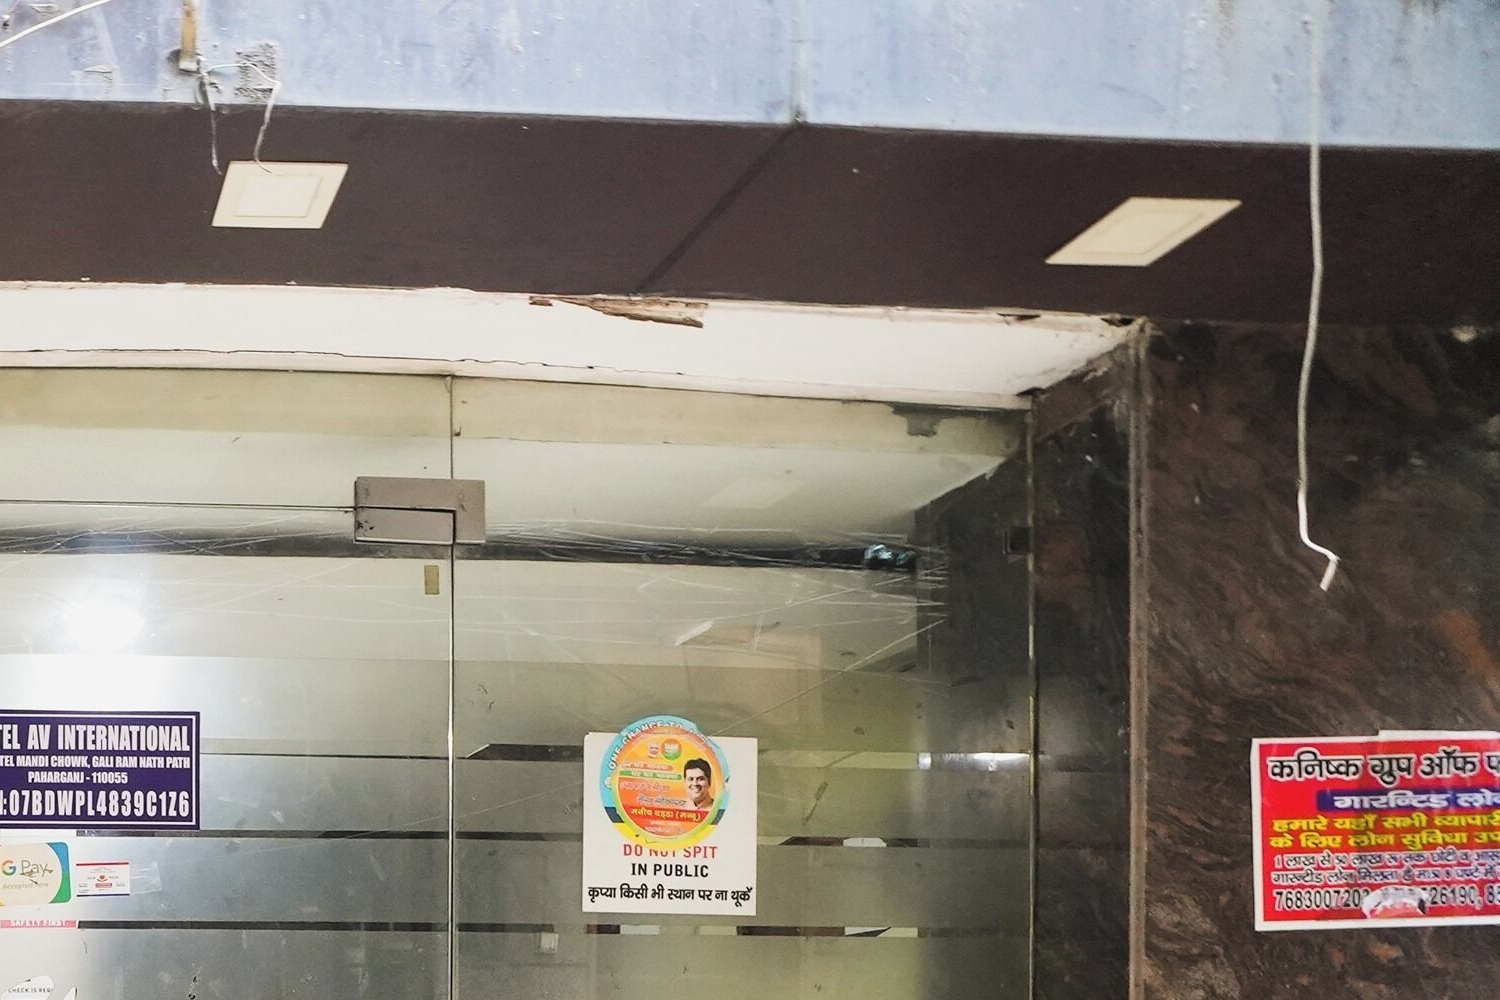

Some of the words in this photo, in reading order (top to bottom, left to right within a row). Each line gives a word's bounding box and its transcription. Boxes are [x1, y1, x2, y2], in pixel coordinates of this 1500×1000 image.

[27, 724, 51, 750] AV
[57, 724, 191, 751] INTERNATIONAL
[16, 755, 49, 768] MANDI
[50, 755, 91, 769] CHOWK,
[92, 756, 114, 768] GALI
[115, 756, 138, 768] RAM
[139, 757, 164, 769] NATH
[166, 757, 191, 769] PATH
[1268, 749, 1363, 778] कनिष्क
[1420, 748, 1479, 776] ऑफ
[27, 771, 84, 783] PAHARGANJ
[92, 772, 129, 784] 110055
[1269, 833, 1294, 847] के
[623, 844, 643, 857] DO
[683, 846, 718, 858] SPIT
[21, 860, 48, 877] Pay
[631, 863, 647, 876] IN
[653, 864, 709, 877] PUBLIC
[587, 886, 616, 902] कृप्या
[620, 883, 648, 899] किसी
[651, 884, 664, 899] भी
[667, 889, 694, 900] स्थान
[698, 889, 711, 900] पर
[715, 889, 728, 901] ना
